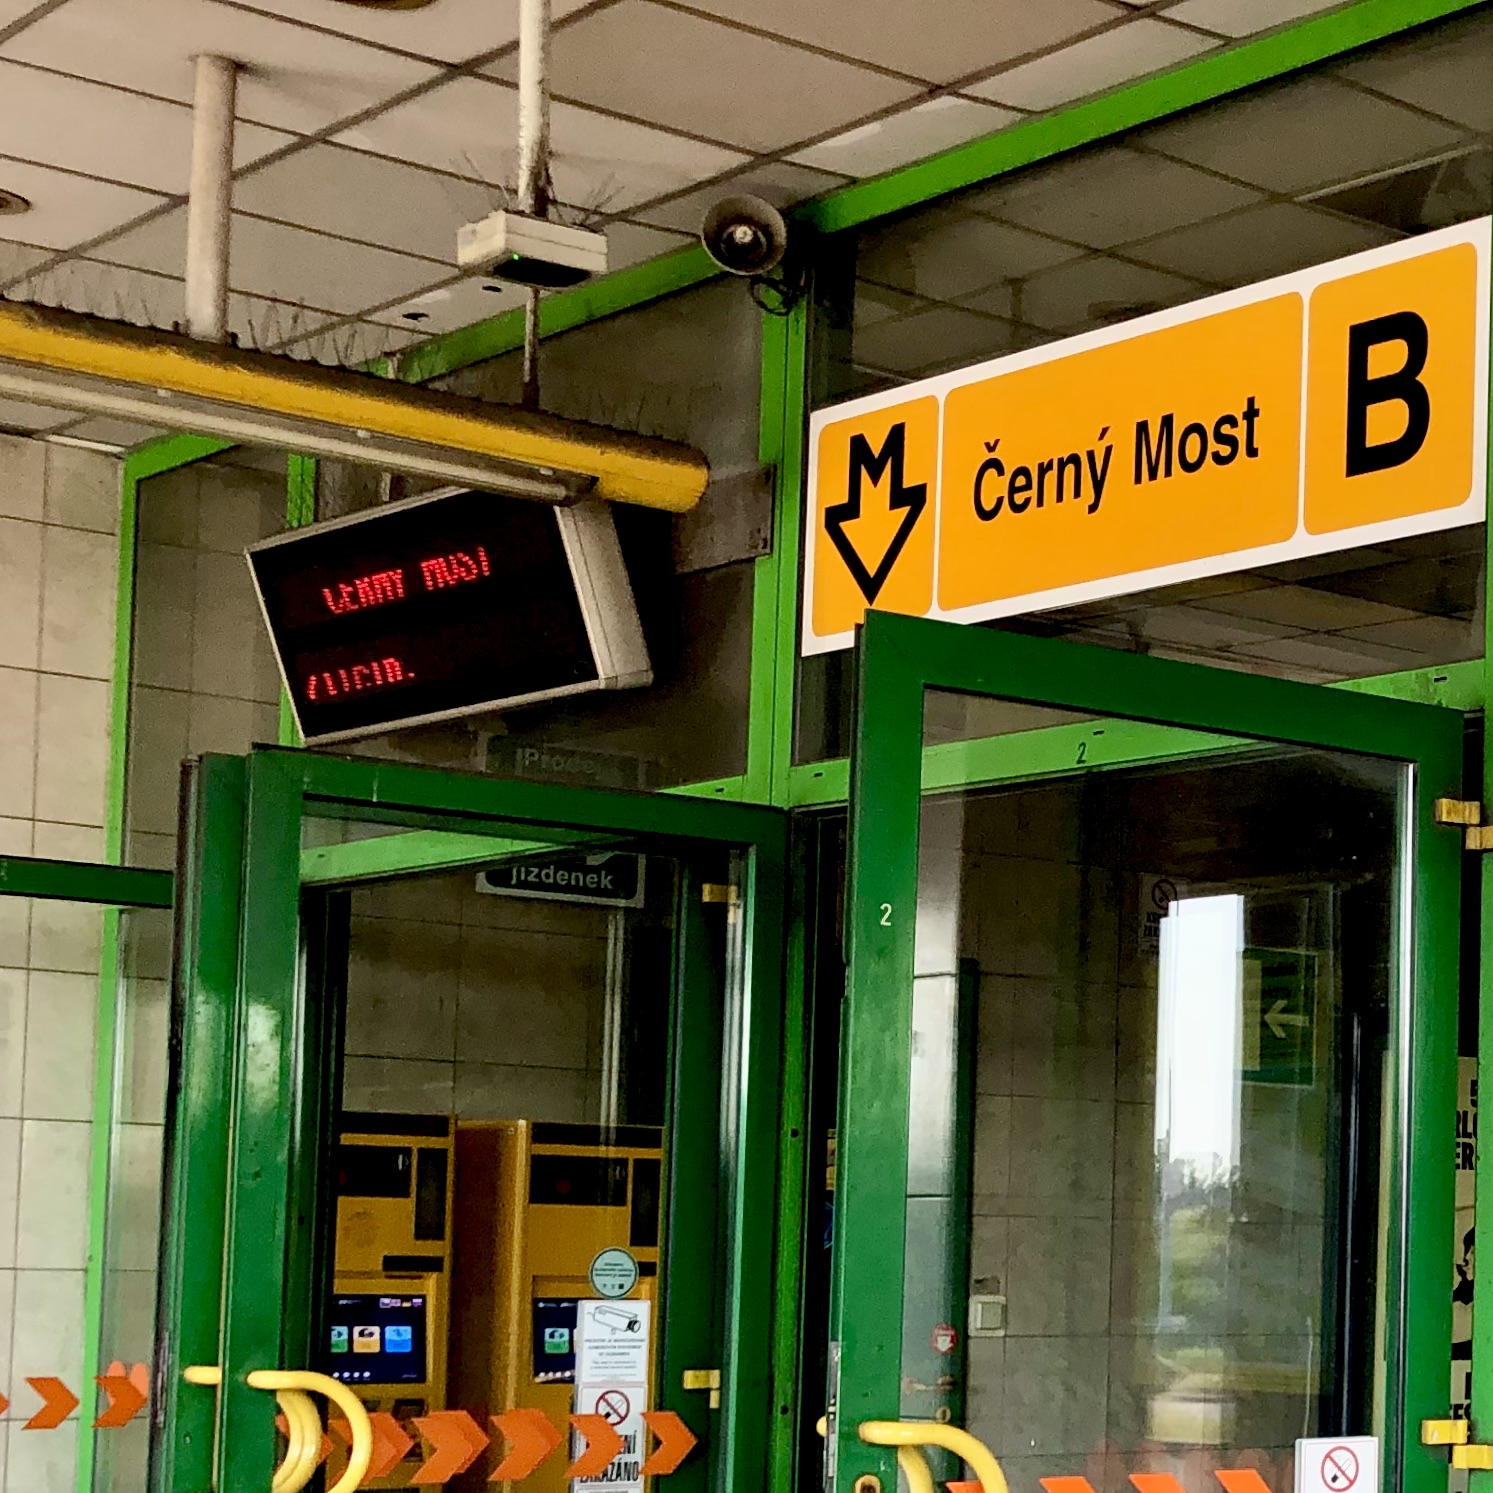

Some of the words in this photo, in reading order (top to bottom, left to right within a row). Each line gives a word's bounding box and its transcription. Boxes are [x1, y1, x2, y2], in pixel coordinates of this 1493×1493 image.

[1345, 310, 1431, 478] B
[973, 426, 1114, 522] Černý
[1133, 395, 1260, 487] Most
[1076, 741, 1087, 764] 2
[879, 902, 893, 926] 2
